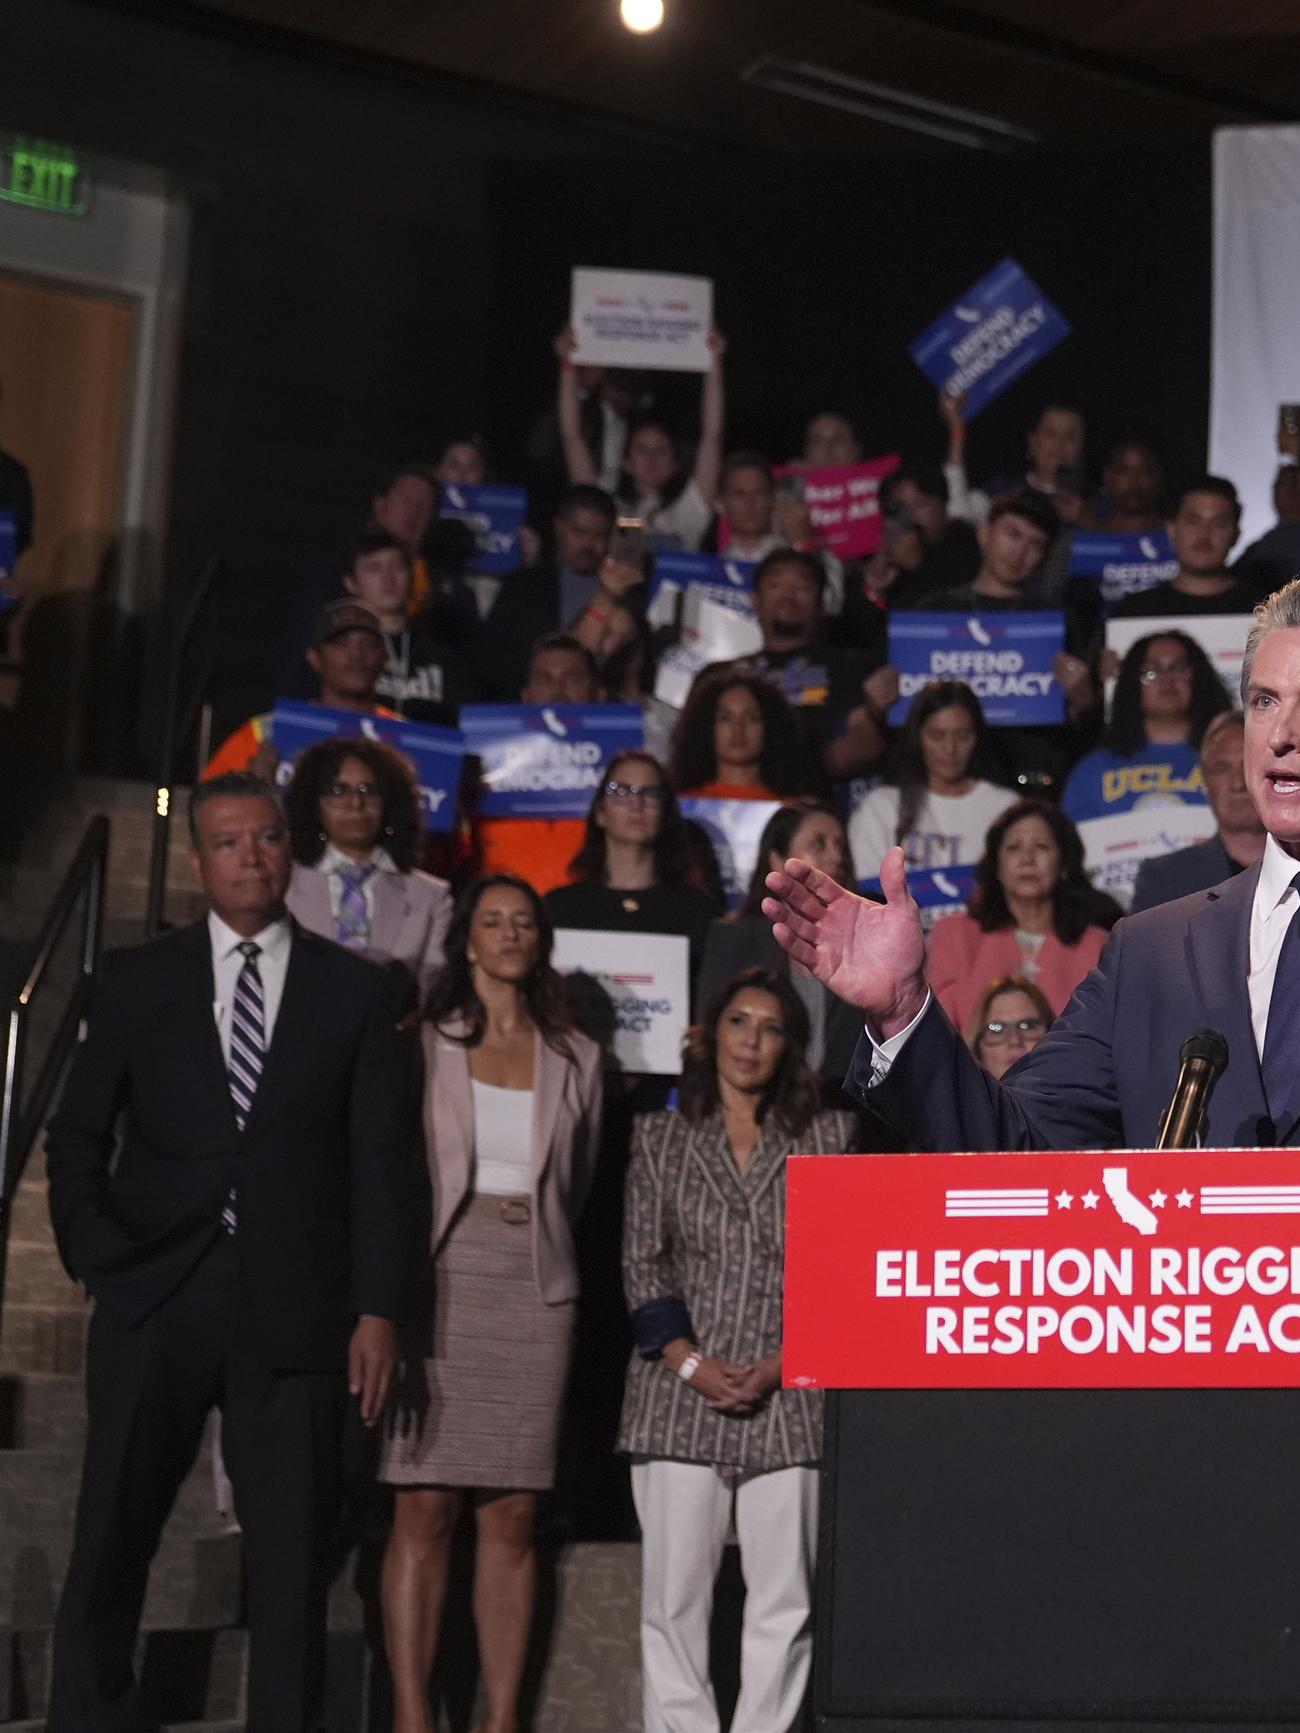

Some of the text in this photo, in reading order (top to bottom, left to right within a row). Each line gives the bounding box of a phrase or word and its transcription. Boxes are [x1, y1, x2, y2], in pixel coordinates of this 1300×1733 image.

[13, 152, 76, 203] EXIT
[930, 650, 1024, 674] DEFEND
[876, 1248, 1133, 1298] ELECTION
[926, 1304, 1213, 1355] RESPONSE
